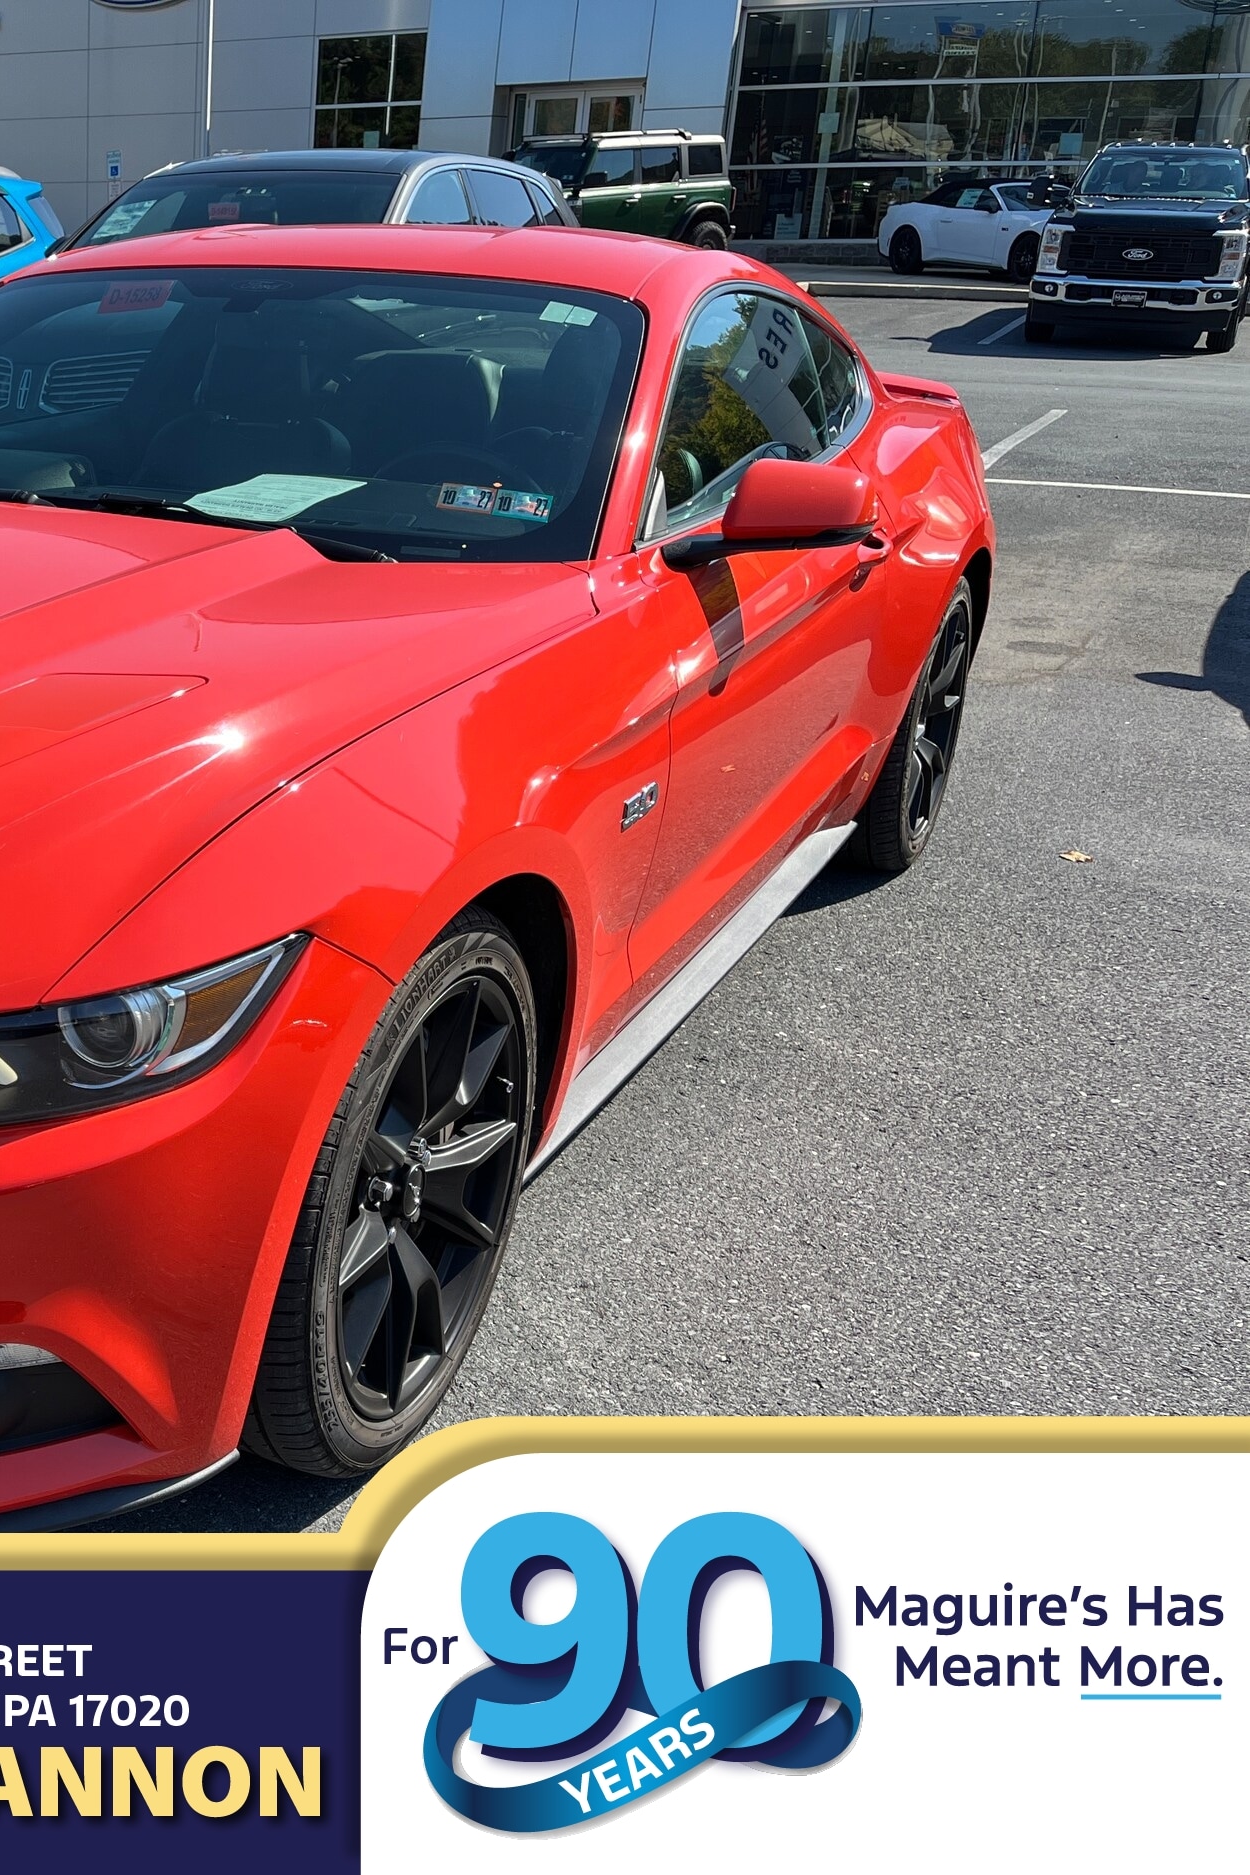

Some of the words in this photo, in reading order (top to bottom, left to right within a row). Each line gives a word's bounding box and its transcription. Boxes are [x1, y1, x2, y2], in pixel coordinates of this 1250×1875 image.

[443, 489, 457, 505] 10
[477, 490, 492, 510] 27
[498, 495, 512, 512] 10
[533, 497, 549, 517] 27
[392, 956, 447, 1035] LIONHART
